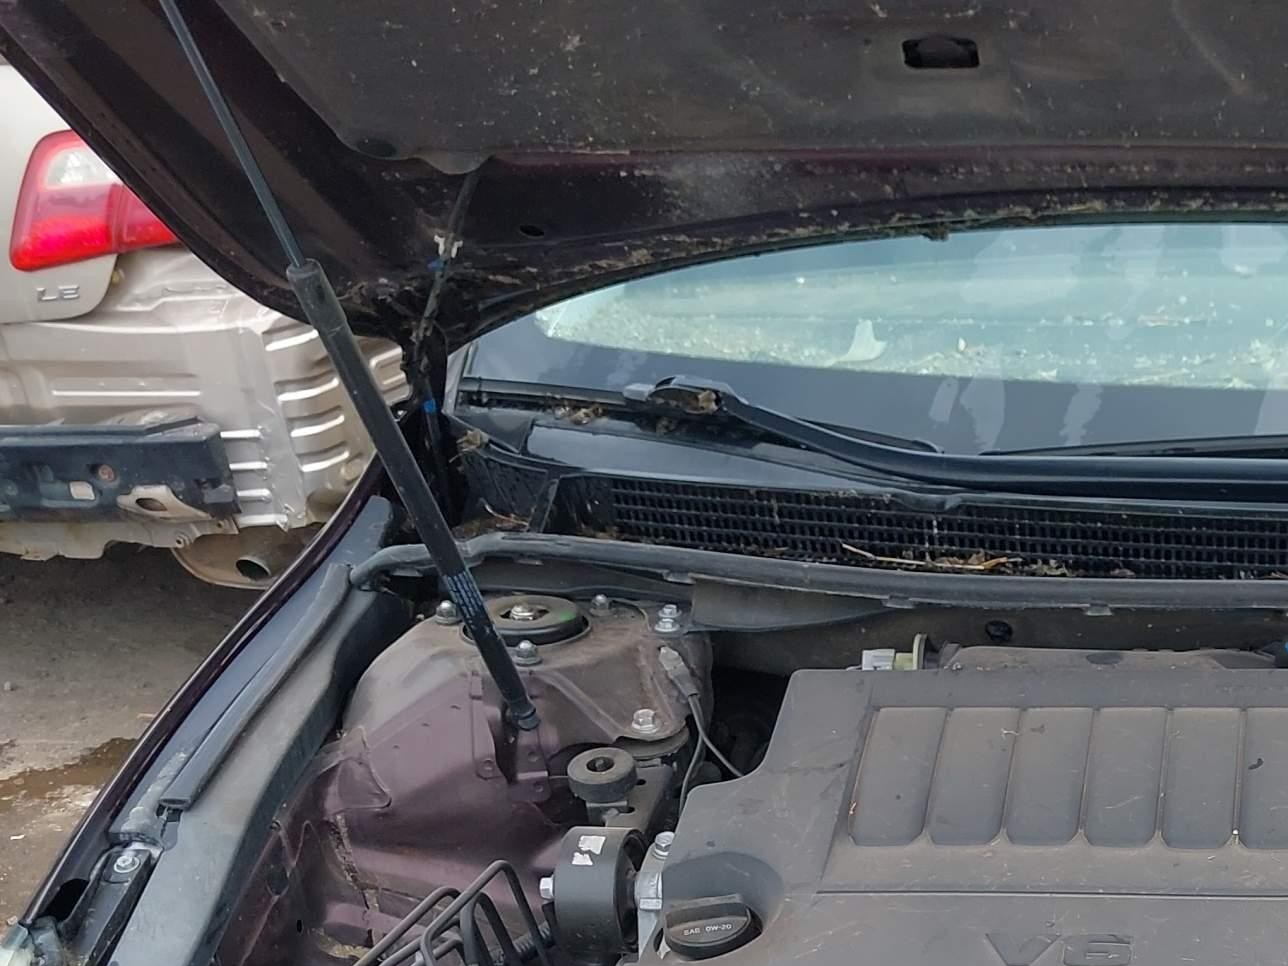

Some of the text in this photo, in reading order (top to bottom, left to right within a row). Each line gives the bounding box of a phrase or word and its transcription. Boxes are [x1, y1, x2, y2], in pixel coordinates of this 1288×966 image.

[35, 284, 80, 302] LE
[683, 923, 732, 936] SAE 0W-20
